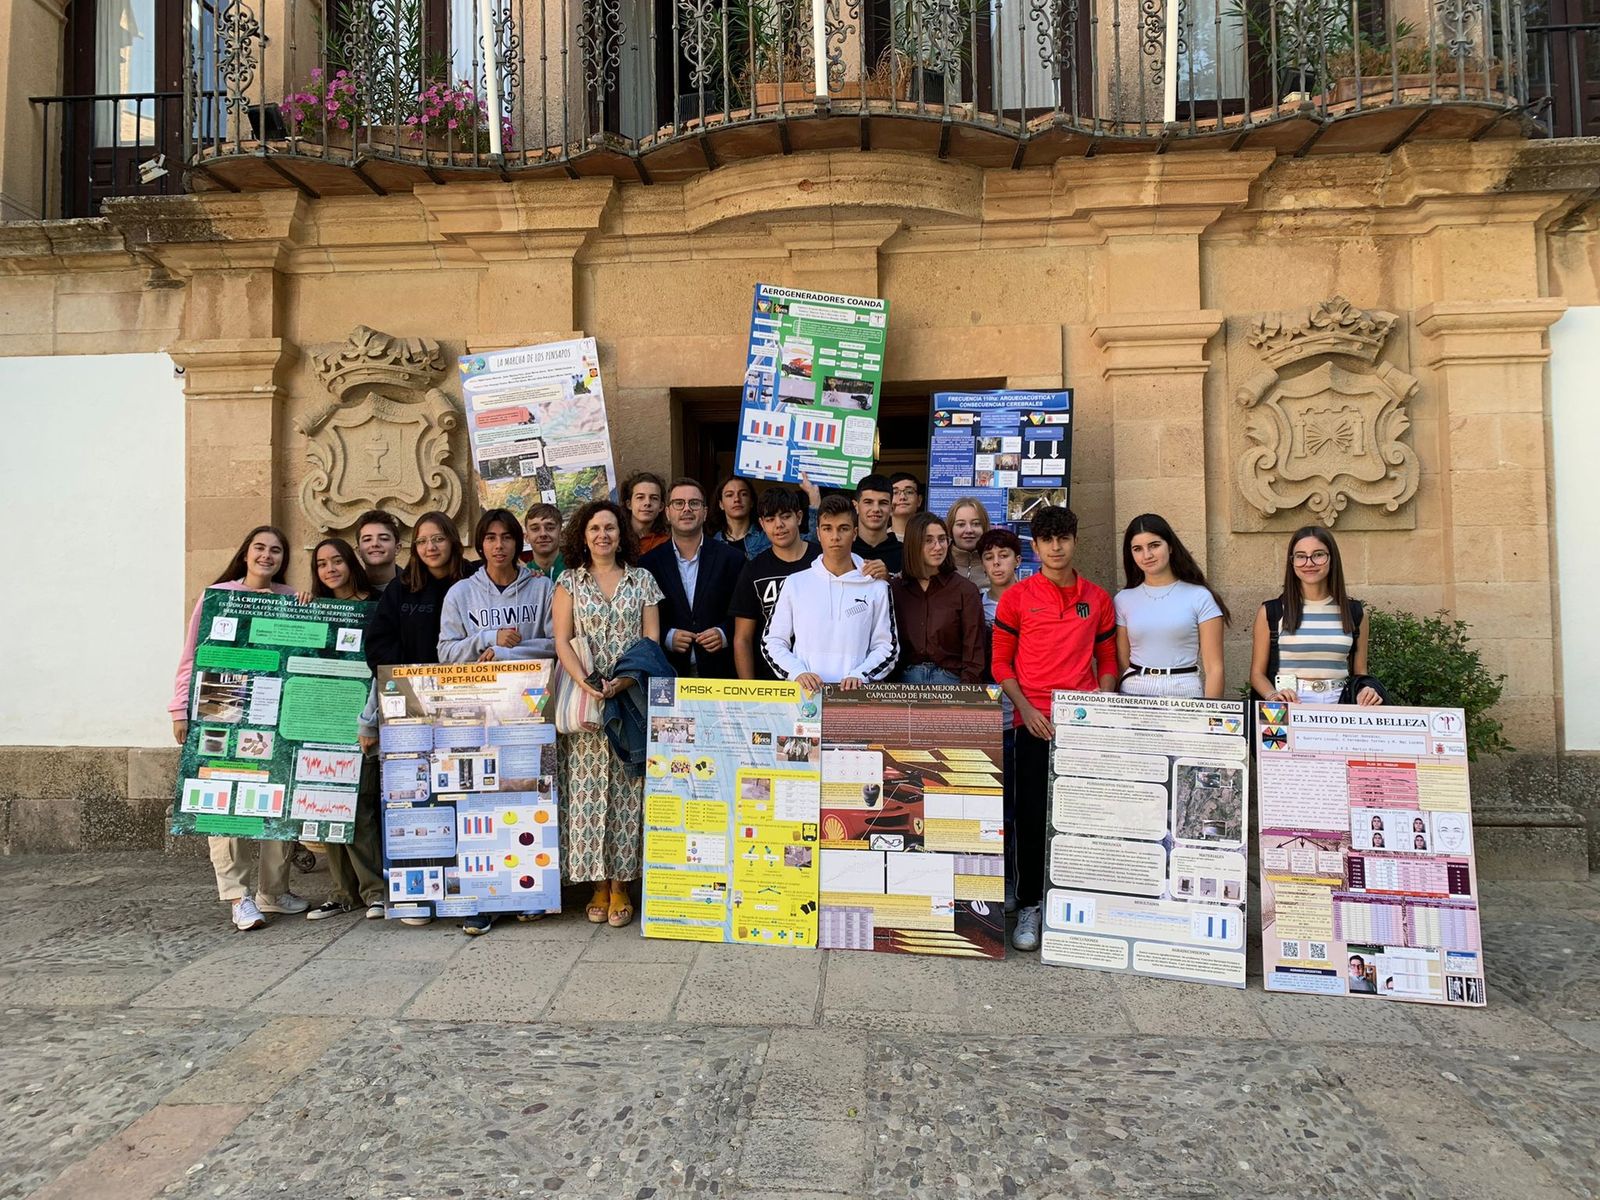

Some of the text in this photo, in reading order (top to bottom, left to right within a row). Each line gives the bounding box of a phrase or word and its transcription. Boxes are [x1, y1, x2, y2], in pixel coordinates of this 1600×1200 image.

[762, 287, 882, 308] AEROGENERADORES COANDA
[497, 349, 571, 367] LA MARCHA DE LOS PINSAPOS
[241, 596, 282, 606] CRIPTONITA
[309, 602, 354, 611] TERREMOTOS
[401, 602, 434, 615] eyes
[468, 604, 538, 628] NORWAY
[456, 666, 469, 674] DE
[471, 665, 488, 673] LOS
[492, 663, 541, 672] INCENDIOS
[680, 685, 712, 694] MASK
[724, 686, 796, 696] CONVERTER
[1067, 695, 1106, 703] CAPACIDAD
[1107, 697, 1158, 706] REGENERATIVA
[1181, 700, 1204, 708] CUEVA
[1292, 714, 1428, 728] EL MITO DE LA BELLEZA
